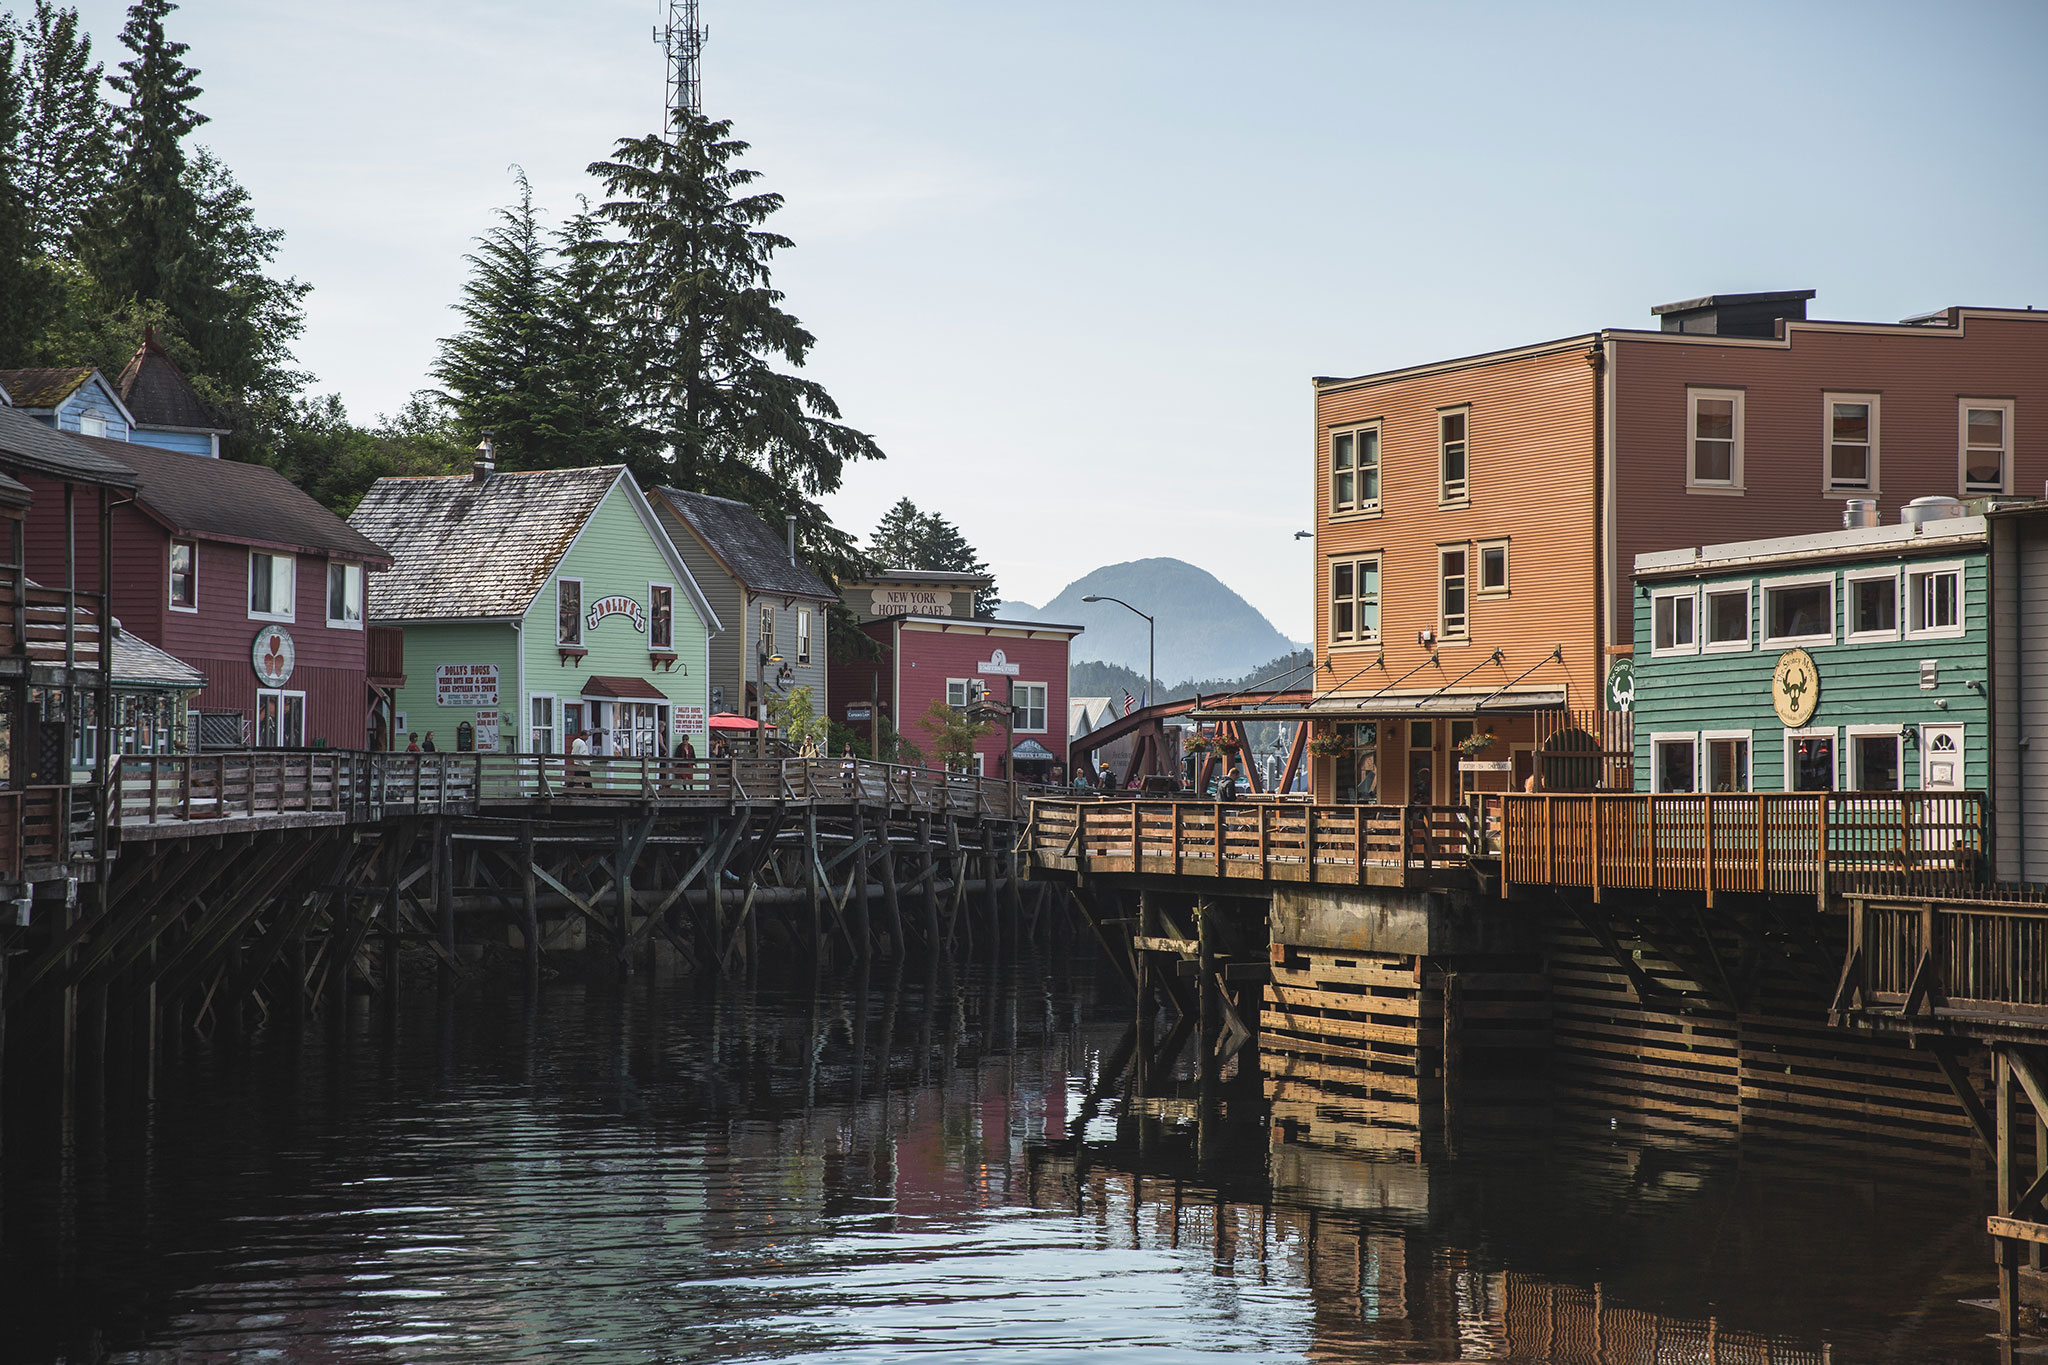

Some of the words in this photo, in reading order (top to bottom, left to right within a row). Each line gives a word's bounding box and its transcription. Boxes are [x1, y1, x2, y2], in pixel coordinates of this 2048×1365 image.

[887, 592, 908, 603] NEW
[911, 592, 936, 604] YORK
[597, 598, 636, 616] DOLLY'S
[879, 604, 907, 615] HOTEL
[912, 605, 919, 614] &
[922, 605, 945, 615] CAFE
[445, 665, 468, 675] DOLLY'S
[470, 665, 490, 675] HOUSE
[475, 676, 480, 684] &
[480, 676, 497, 684] SALMON
